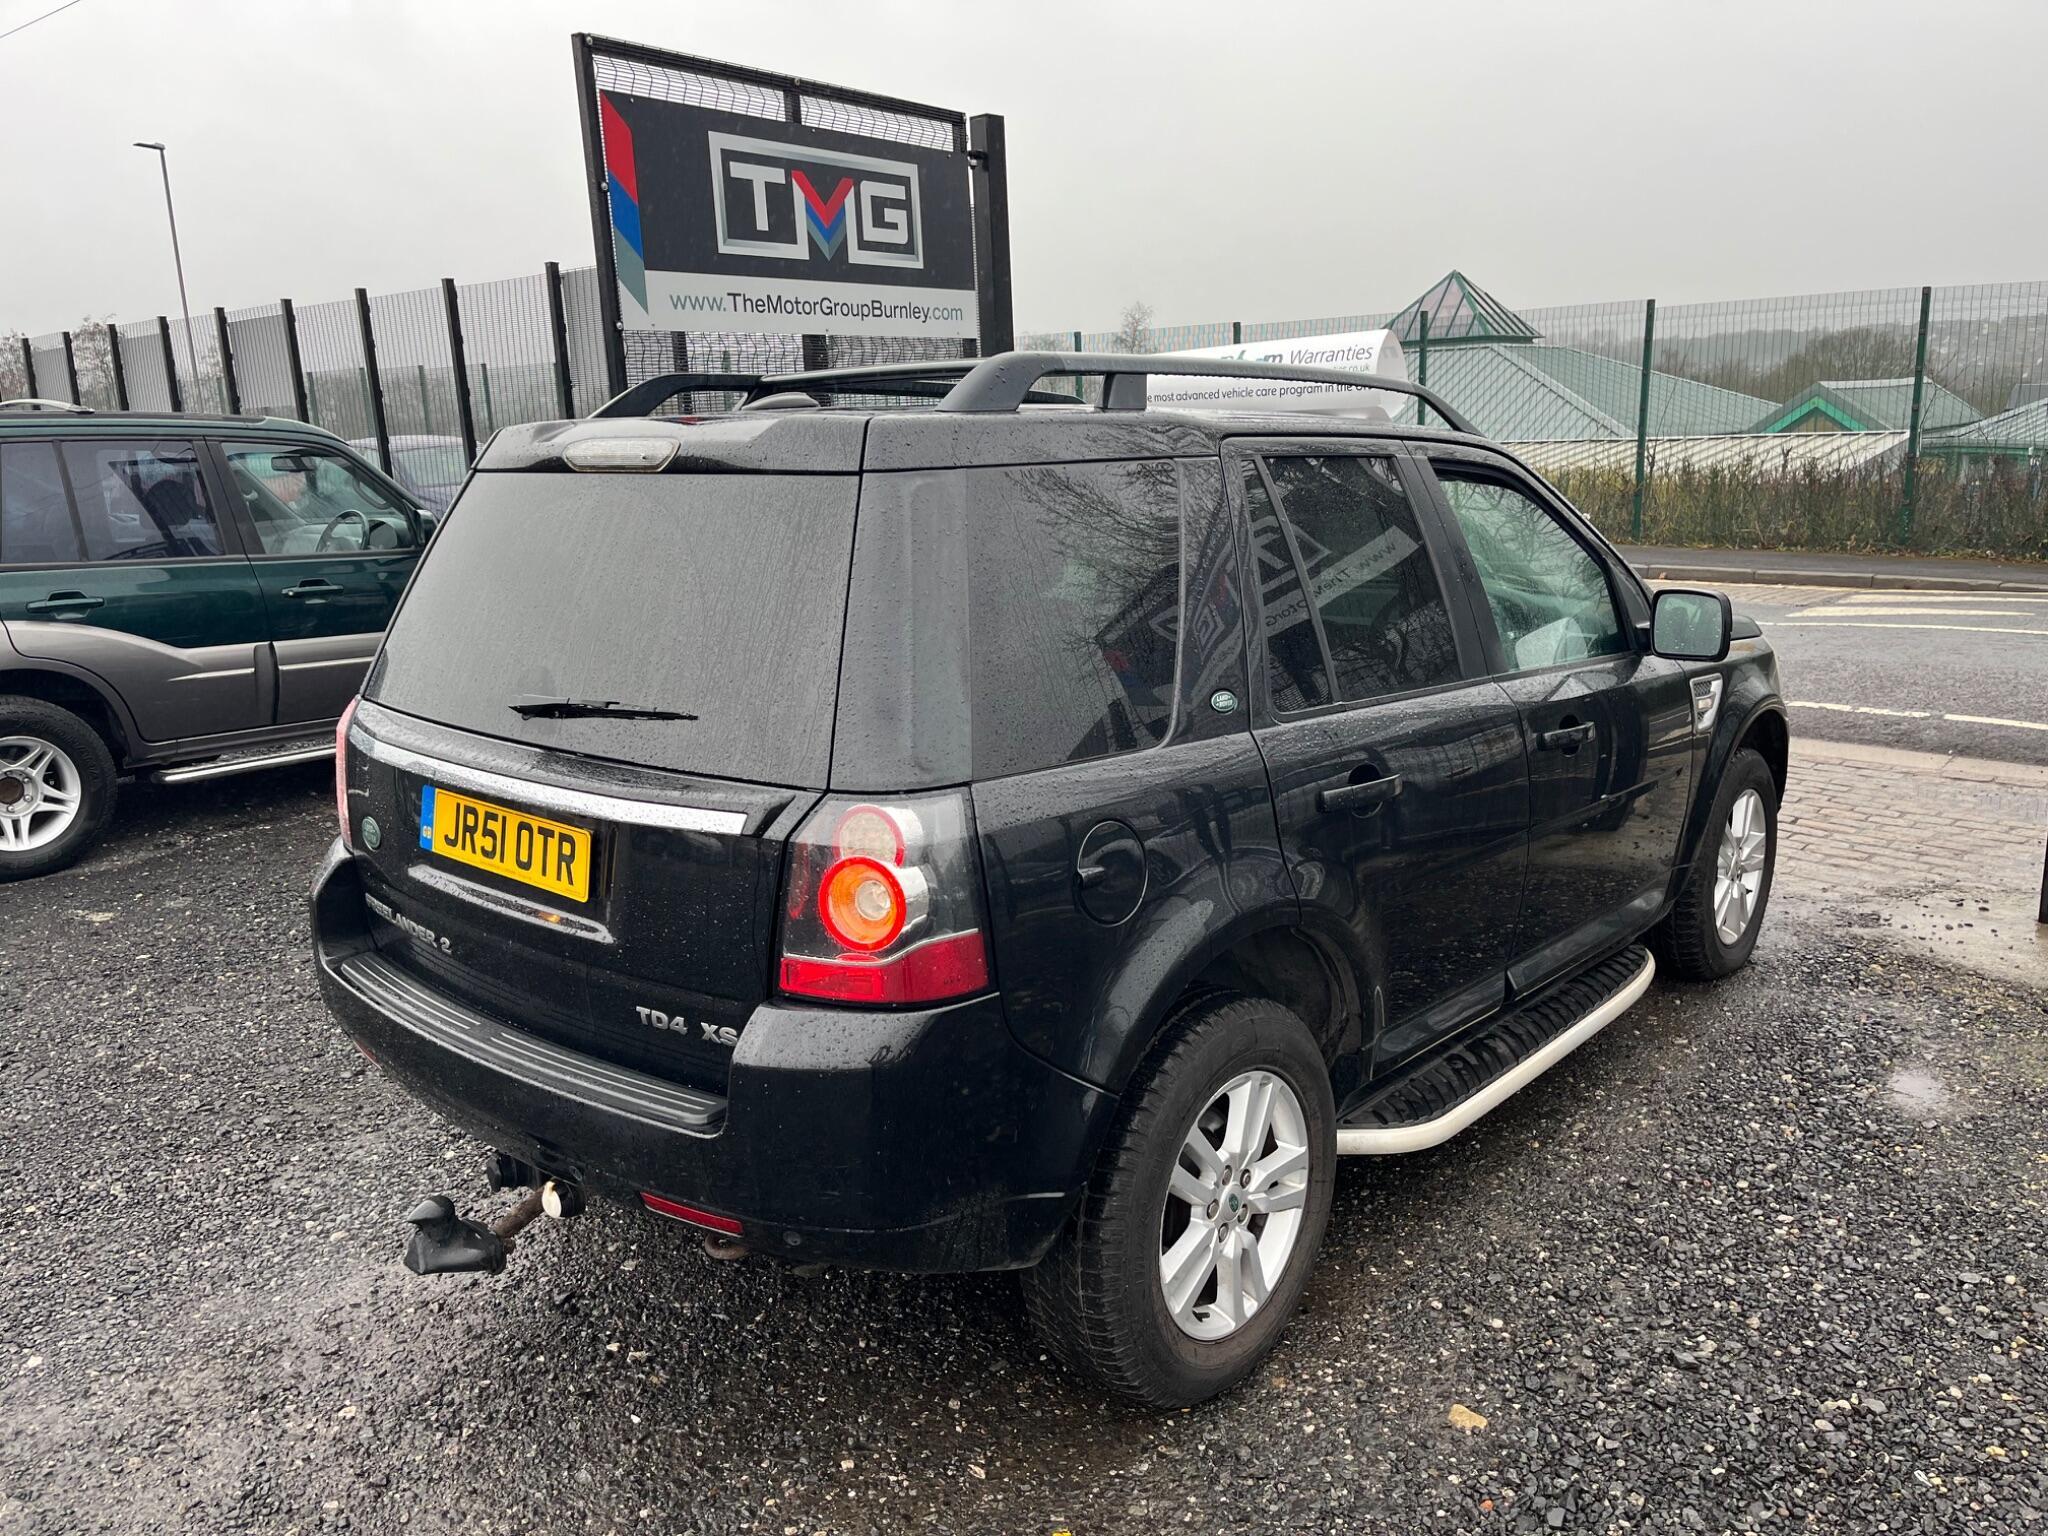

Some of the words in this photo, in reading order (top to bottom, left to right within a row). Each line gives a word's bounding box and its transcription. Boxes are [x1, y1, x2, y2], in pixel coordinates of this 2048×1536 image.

[728, 161, 908, 261] TMG
[668, 292, 963, 323] www.TheMotorGroupBurnley.com
[1290, 344, 1374, 365] Warranties
[1154, 391, 1175, 402] most
[1176, 388, 1220, 401] advanced
[1221, 386, 1254, 399] vehicle
[1256, 386, 1277, 397] care
[1280, 384, 1323, 398] program
[443, 802, 507, 864] JR51
[515, 821, 576, 886] OTR
[440, 937, 452, 953] 2
[635, 1005, 688, 1036] TD4
[700, 1021, 738, 1047] XS
